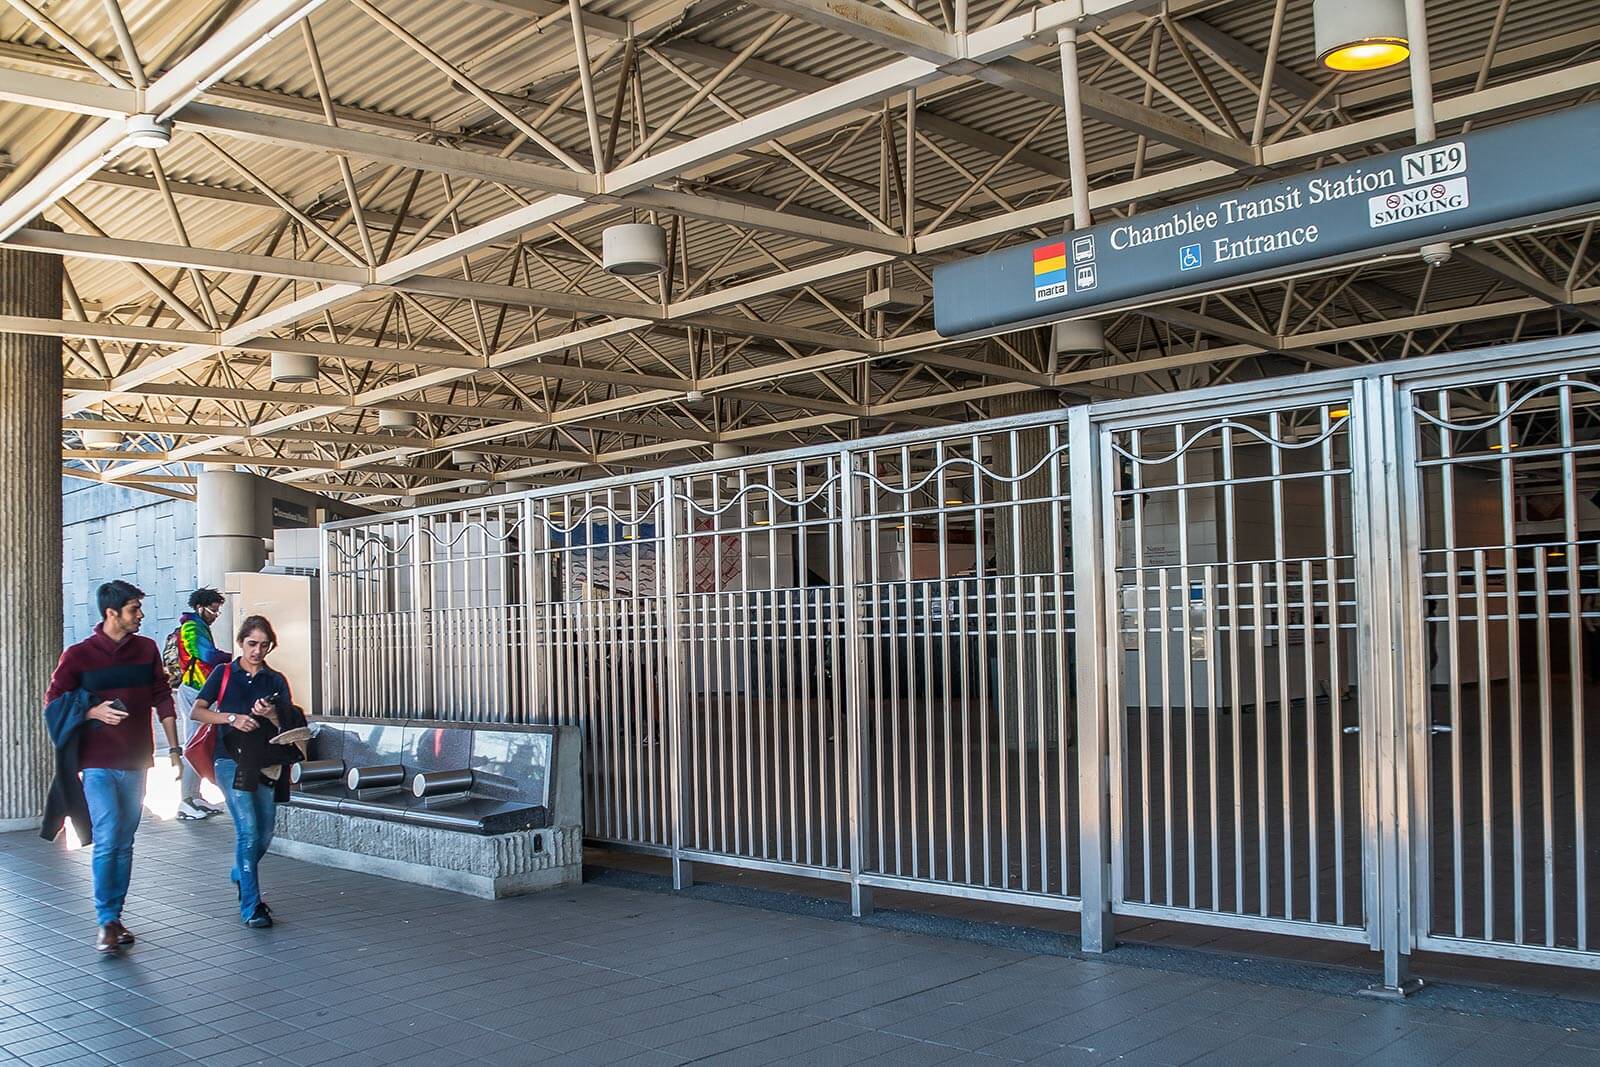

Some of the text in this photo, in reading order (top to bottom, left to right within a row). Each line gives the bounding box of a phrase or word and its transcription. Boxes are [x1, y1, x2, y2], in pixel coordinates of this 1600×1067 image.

[1405, 147, 1462, 180] NE9
[1110, 168, 1397, 251] Chamblee Transit Station
[1374, 194, 1463, 225] SMOKING
[1402, 189, 1428, 203] NO
[1214, 224, 1319, 263] Entrance
[1037, 285, 1065, 298] marta
